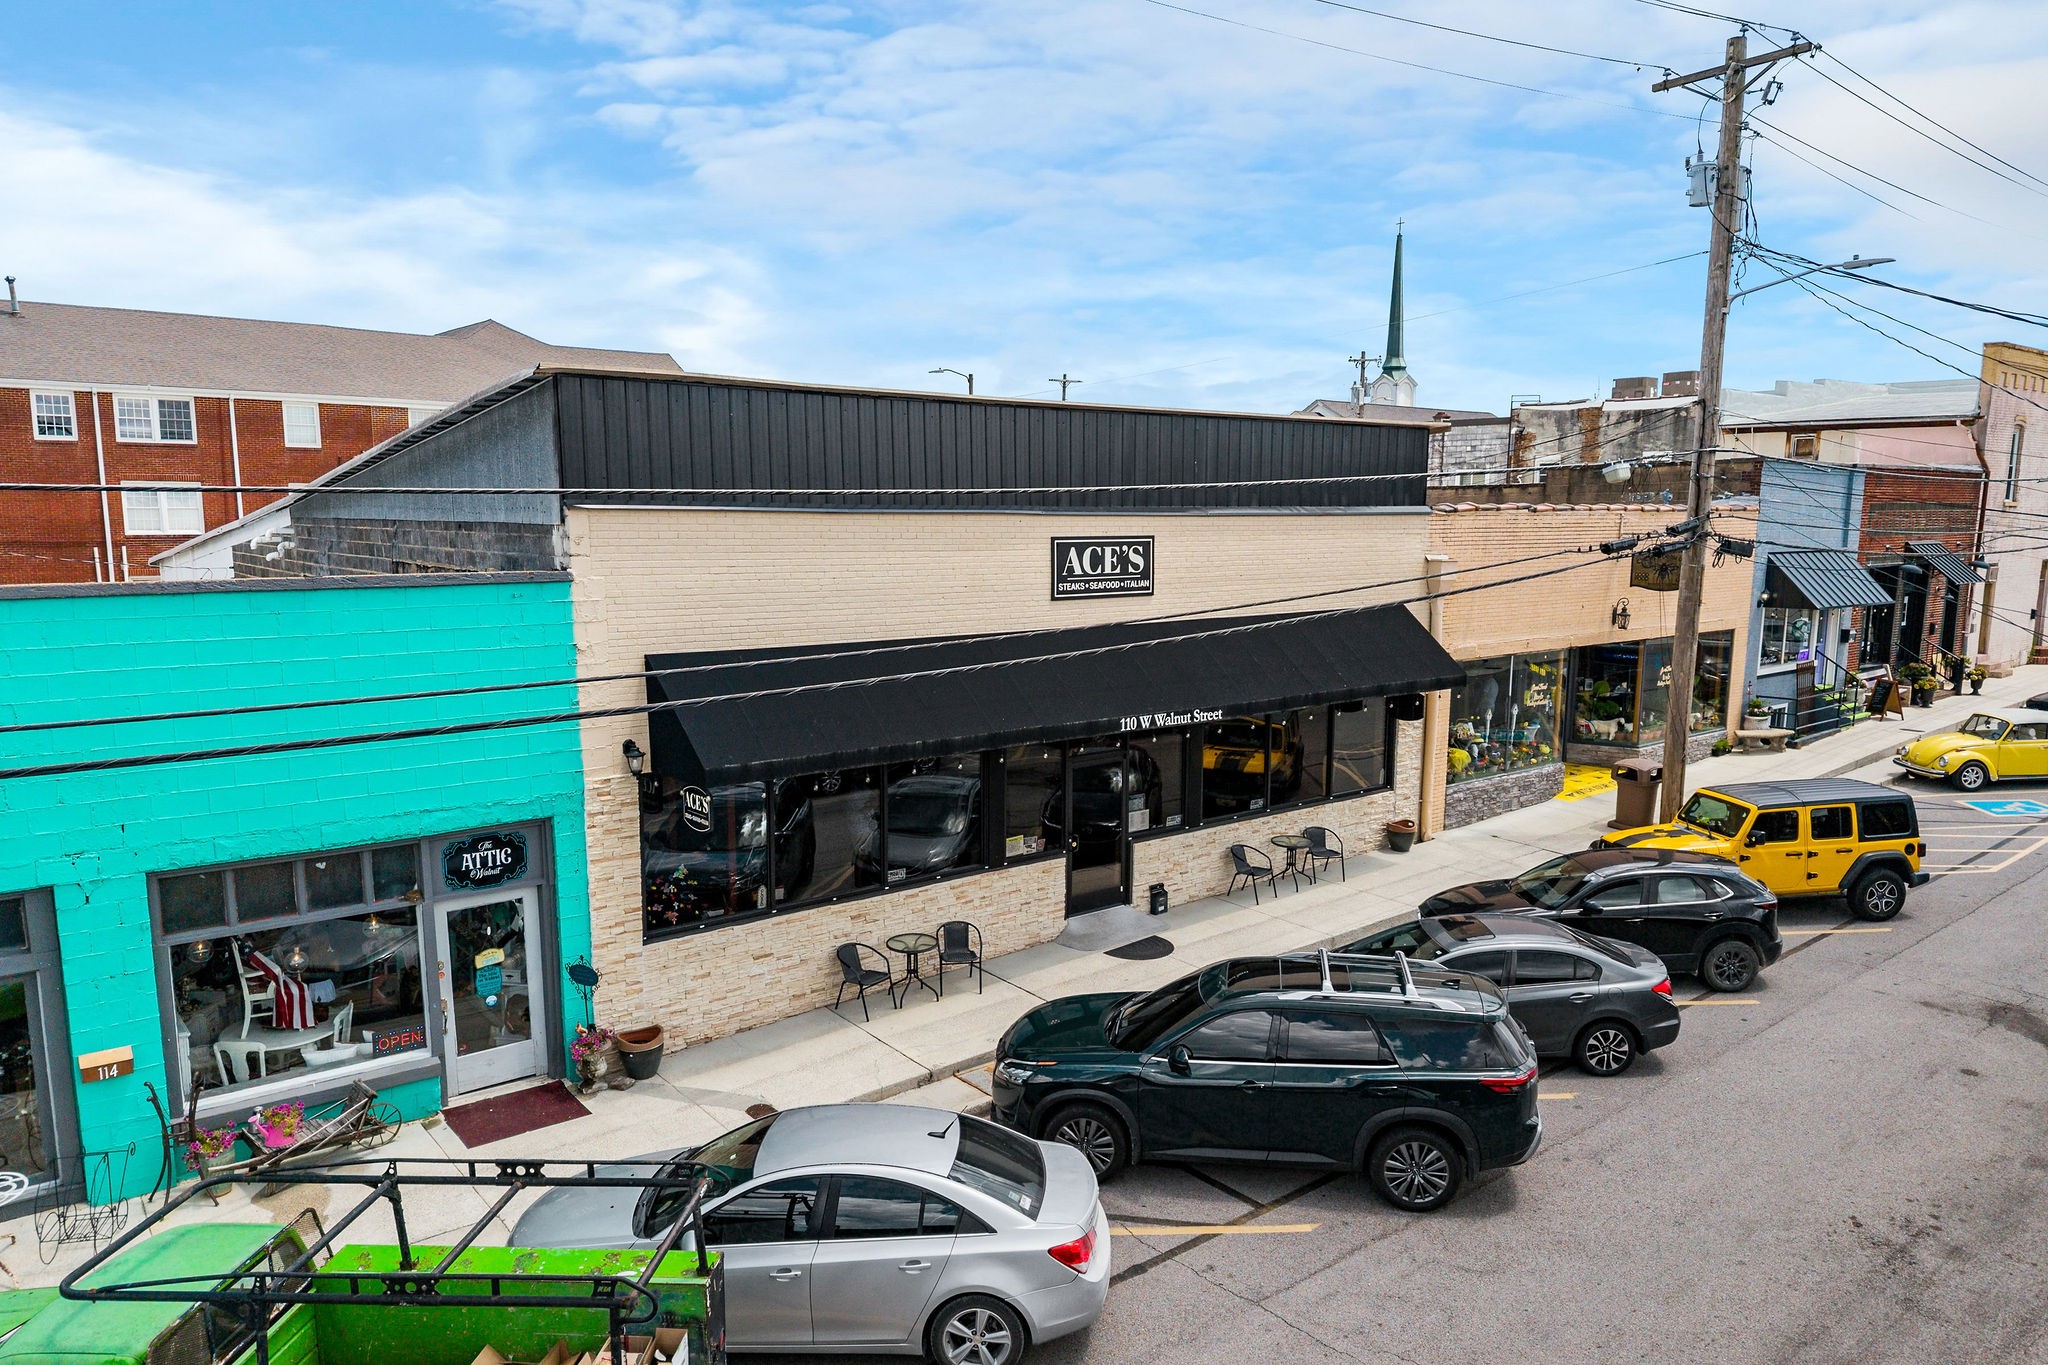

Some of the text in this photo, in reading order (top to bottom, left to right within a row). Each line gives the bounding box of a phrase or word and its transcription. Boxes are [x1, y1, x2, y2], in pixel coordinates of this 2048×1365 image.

[1062, 544, 1145, 576] ACE'S
[1119, 708, 1223, 732] 110 W Walnut Street
[685, 791, 709, 814] ACE'S
[478, 840, 493, 852] The
[461, 847, 512, 871] ATTIC
[378, 1030, 421, 1050] OPEN
[97, 1064, 119, 1081] 114
